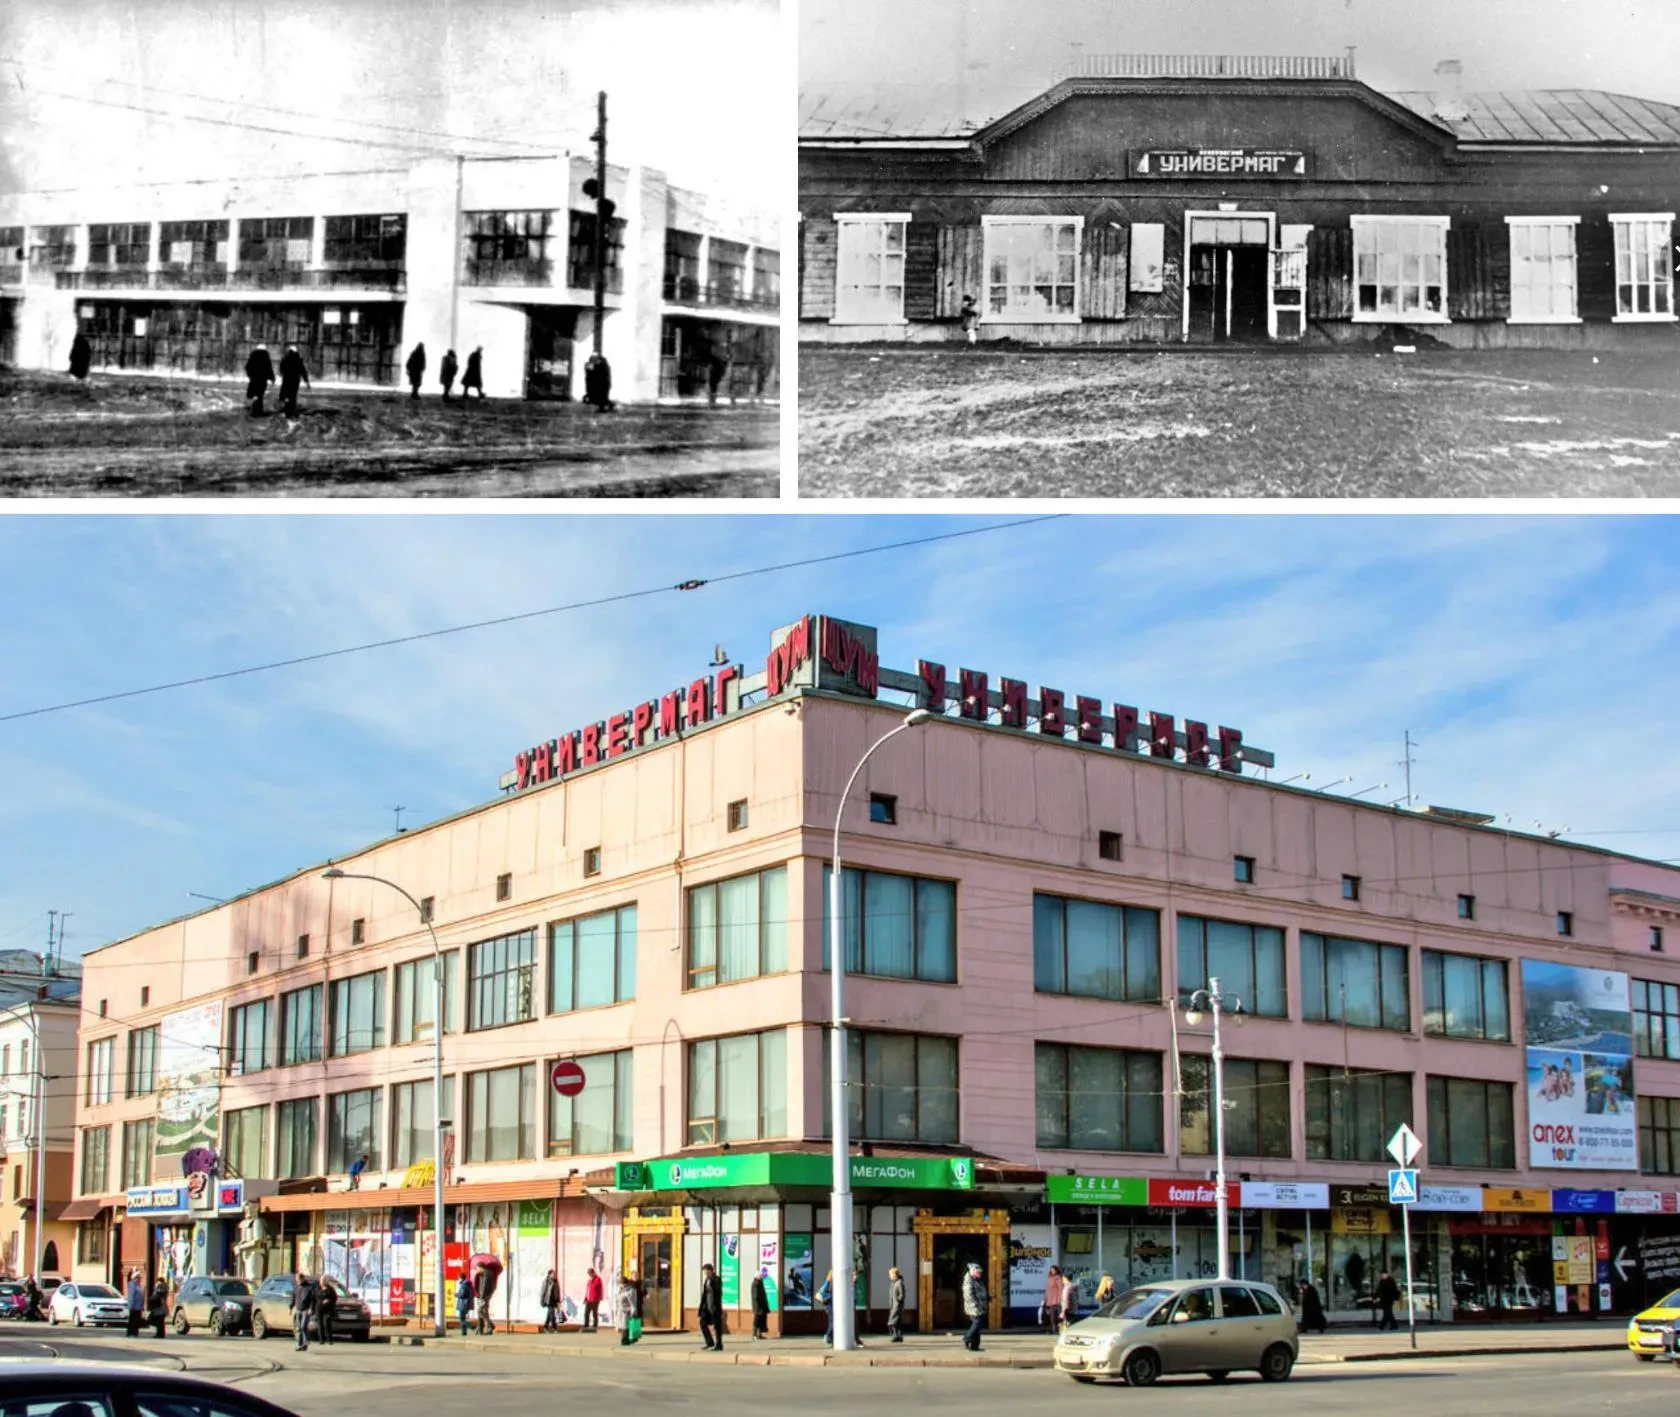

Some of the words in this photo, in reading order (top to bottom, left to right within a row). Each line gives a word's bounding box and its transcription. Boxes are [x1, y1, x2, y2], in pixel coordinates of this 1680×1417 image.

[1159, 155, 1287, 173] УНИВЕРМАГ
[766, 613, 809, 697] ЦУМ
[820, 614, 879, 699] ЦУМ
[917, 658, 1243, 774] УНИВЕРМАГ
[515, 664, 736, 790] УНИВЕРМАГ
[1532, 1123, 1575, 1144] anex
[1551, 1145, 1576, 1162] tour
[1074, 1177, 1120, 1190] SELA
[1168, 1185, 1195, 1202] tom
[522, 1213, 546, 1225] SELA
